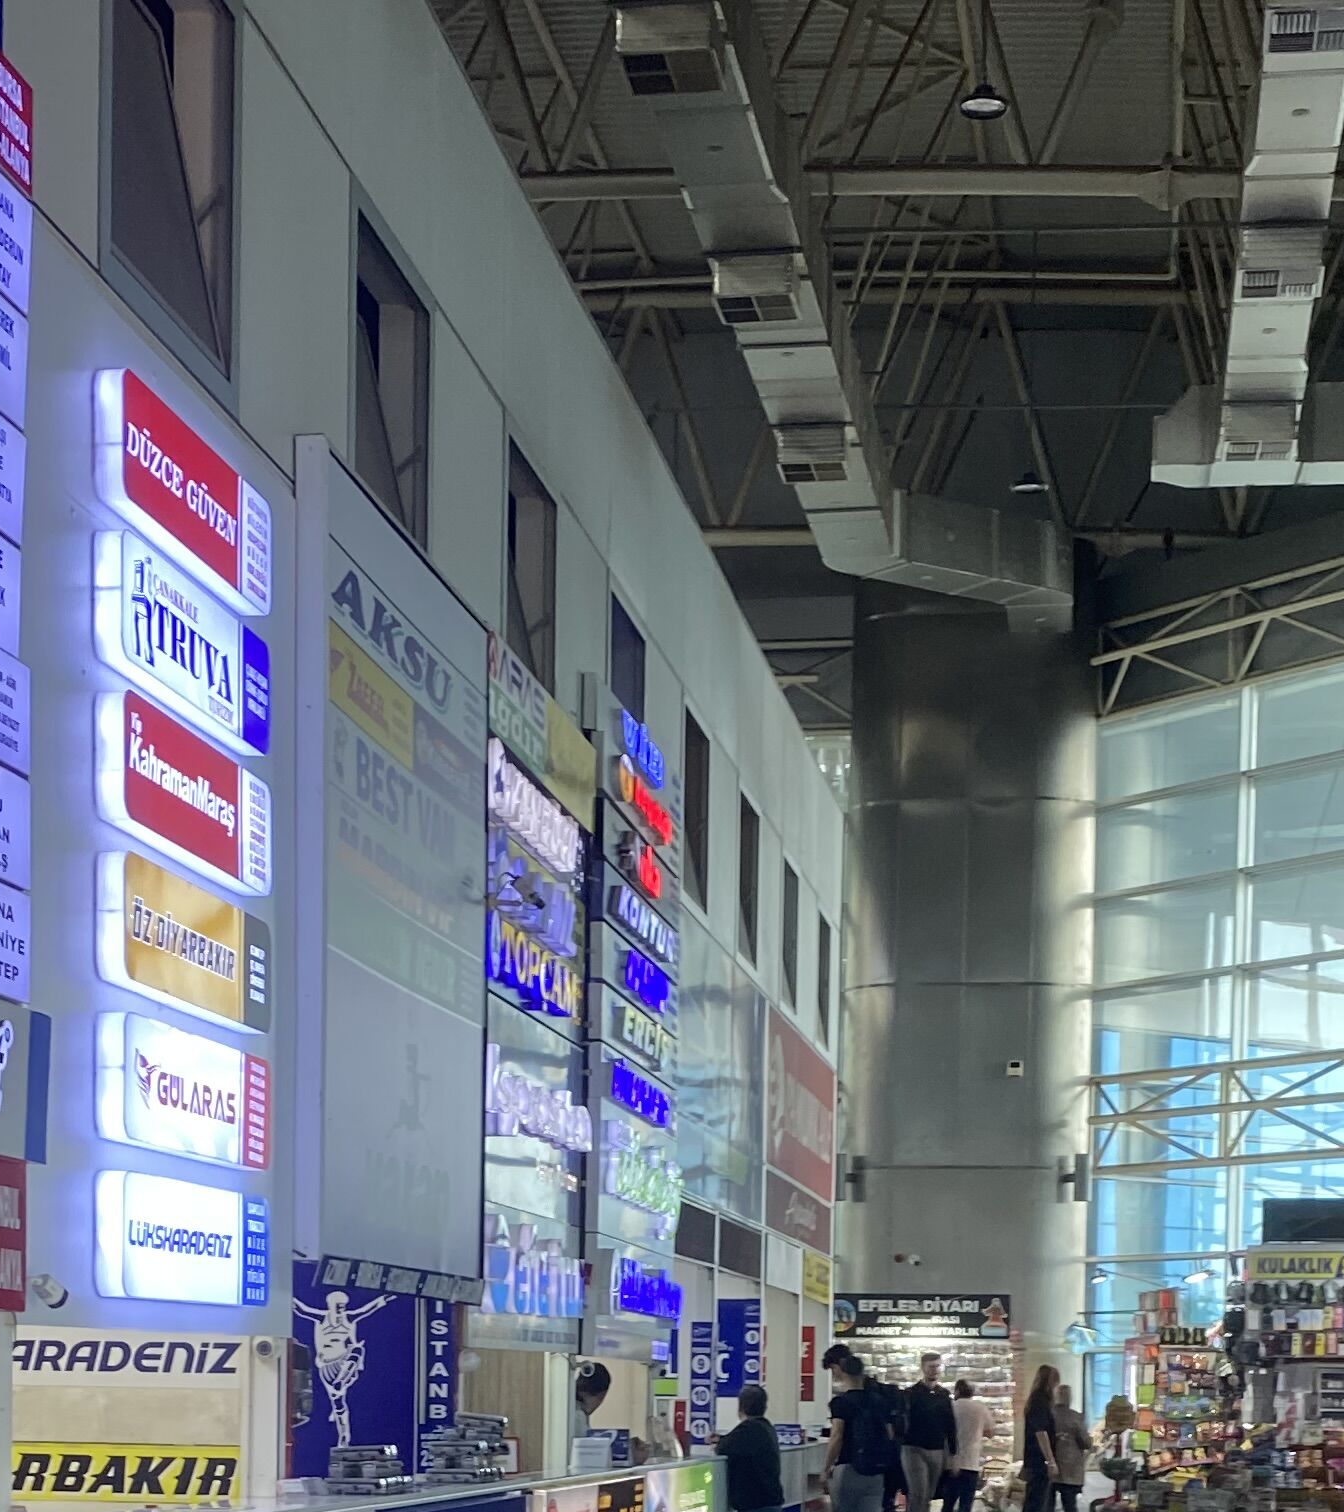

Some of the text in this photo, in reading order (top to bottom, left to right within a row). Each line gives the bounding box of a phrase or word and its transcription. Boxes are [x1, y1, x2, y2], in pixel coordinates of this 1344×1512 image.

[126, 421, 238, 547] DÜZCE GÜVEN
[331, 569, 453, 710] AKSU
